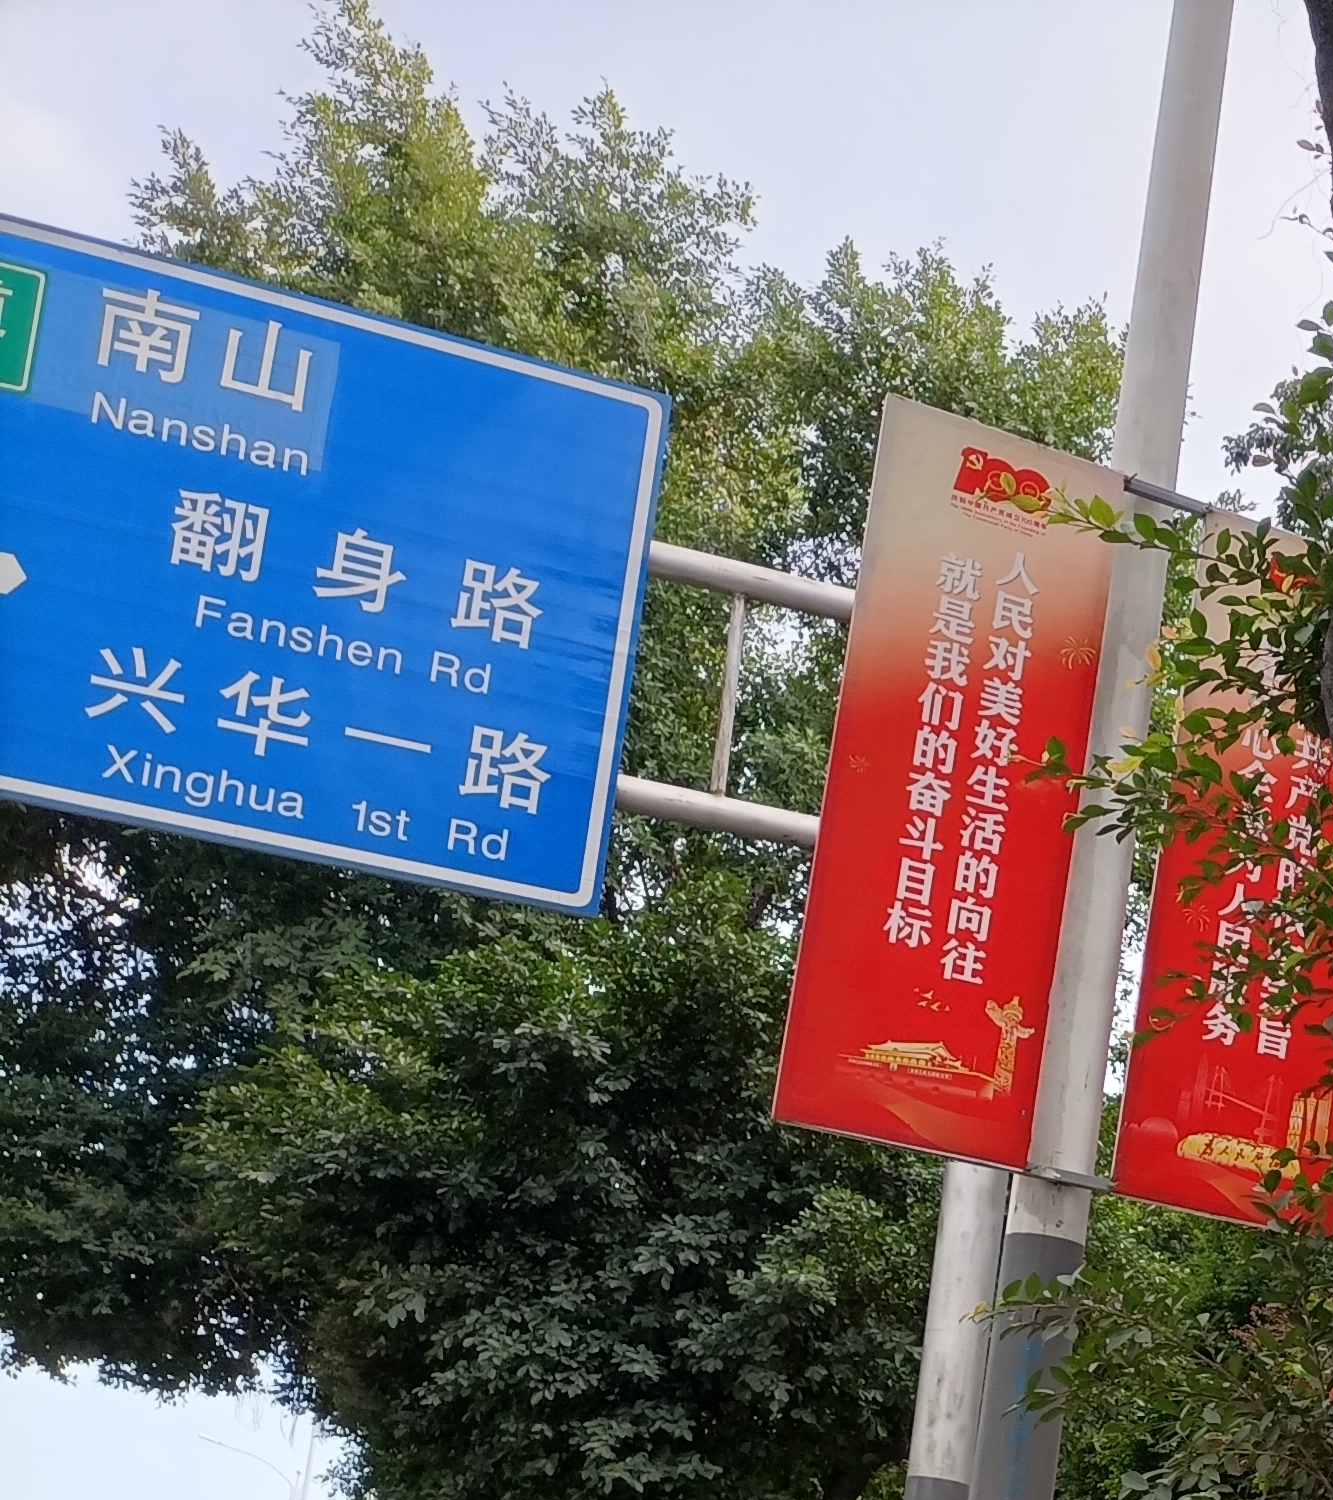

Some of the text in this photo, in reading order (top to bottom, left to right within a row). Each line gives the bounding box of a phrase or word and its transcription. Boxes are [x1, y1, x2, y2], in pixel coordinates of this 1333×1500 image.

[97, 287, 314, 412] 南山
[90, 391, 310, 476] Nanshan
[168, 488, 544, 650] 翻身路
[194, 595, 492, 695] Fanshen Rd
[85, 647, 552, 816] 兴华一路
[882, 552, 984, 950] 就是我们的奋斗目标
[939, 552, 1040, 987] 人民对美好生活的向往
[102, 745, 509, 862] Xinghua 1st Rd
